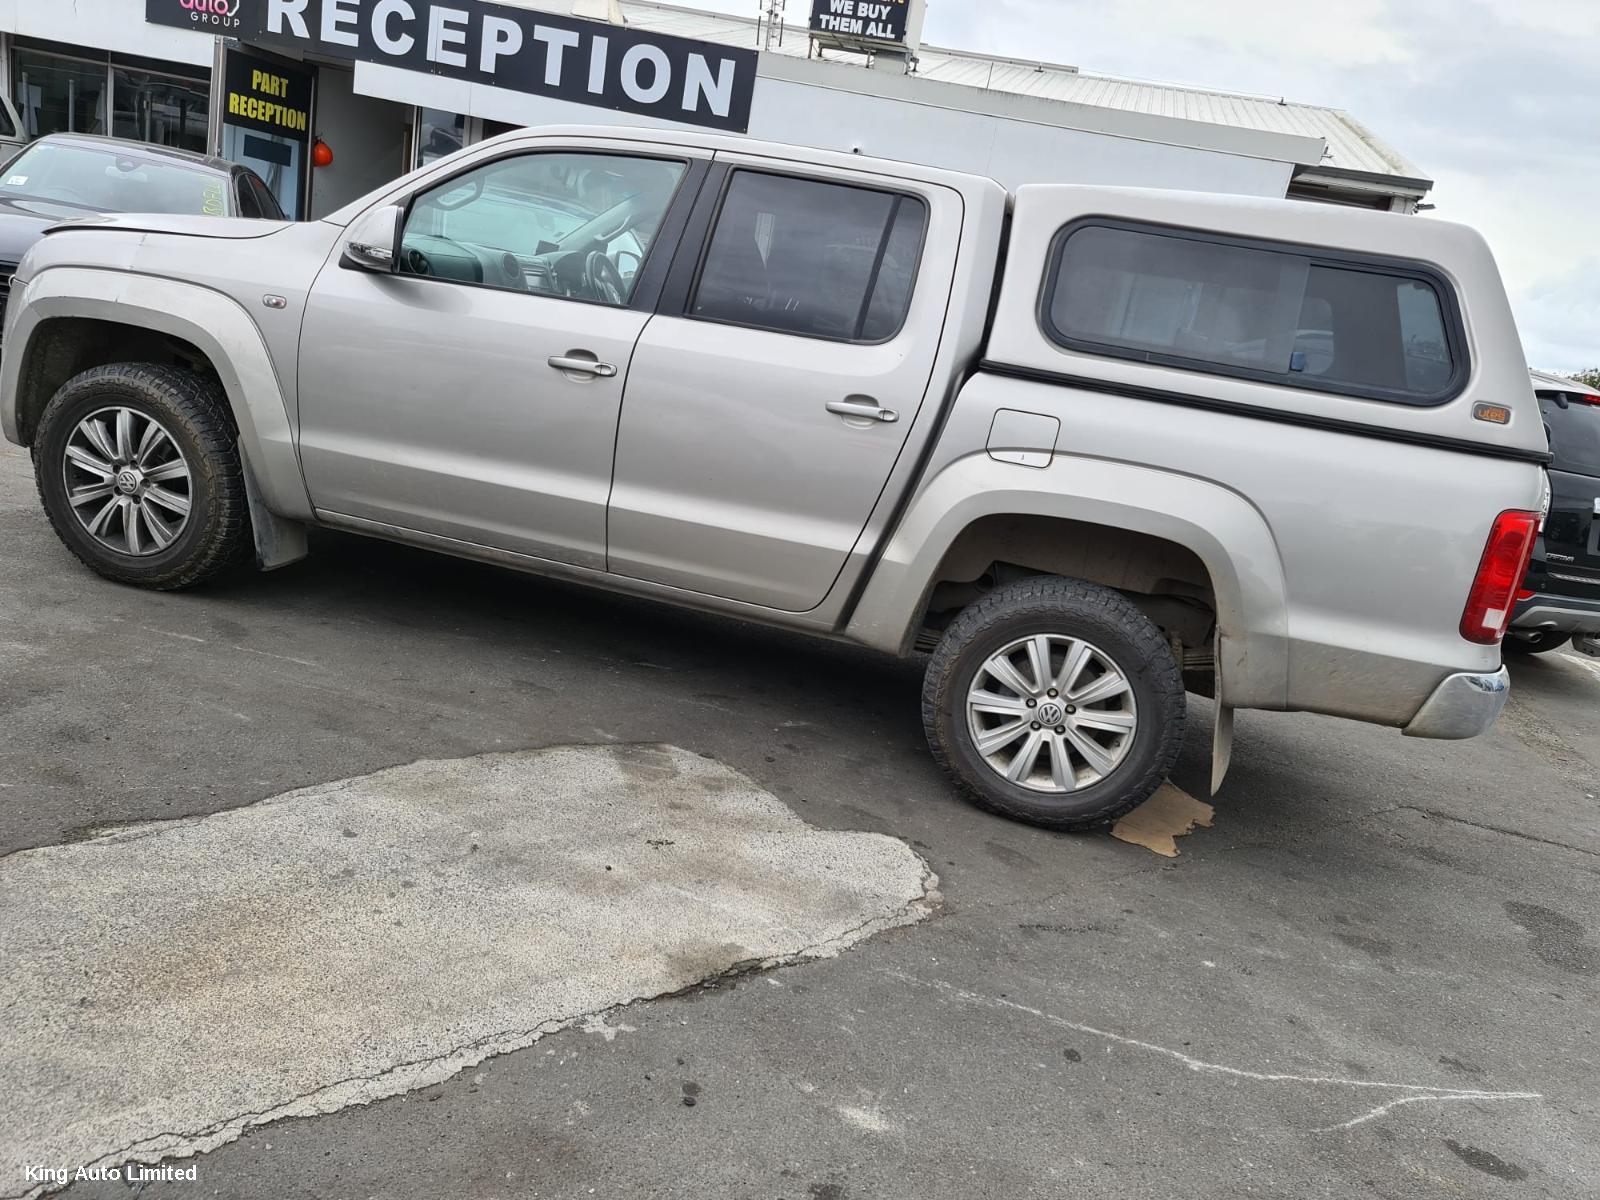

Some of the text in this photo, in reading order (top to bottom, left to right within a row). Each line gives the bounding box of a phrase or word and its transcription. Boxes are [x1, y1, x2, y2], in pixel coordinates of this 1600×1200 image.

[190, 11, 240, 28] GROUP
[830, 0, 891, 20] WE BUY
[819, 14, 895, 39] THEM ALL
[267, 0, 736, 118] RECEPTION
[252, 69, 288, 98] PART
[229, 92, 306, 131] RECEPTION
